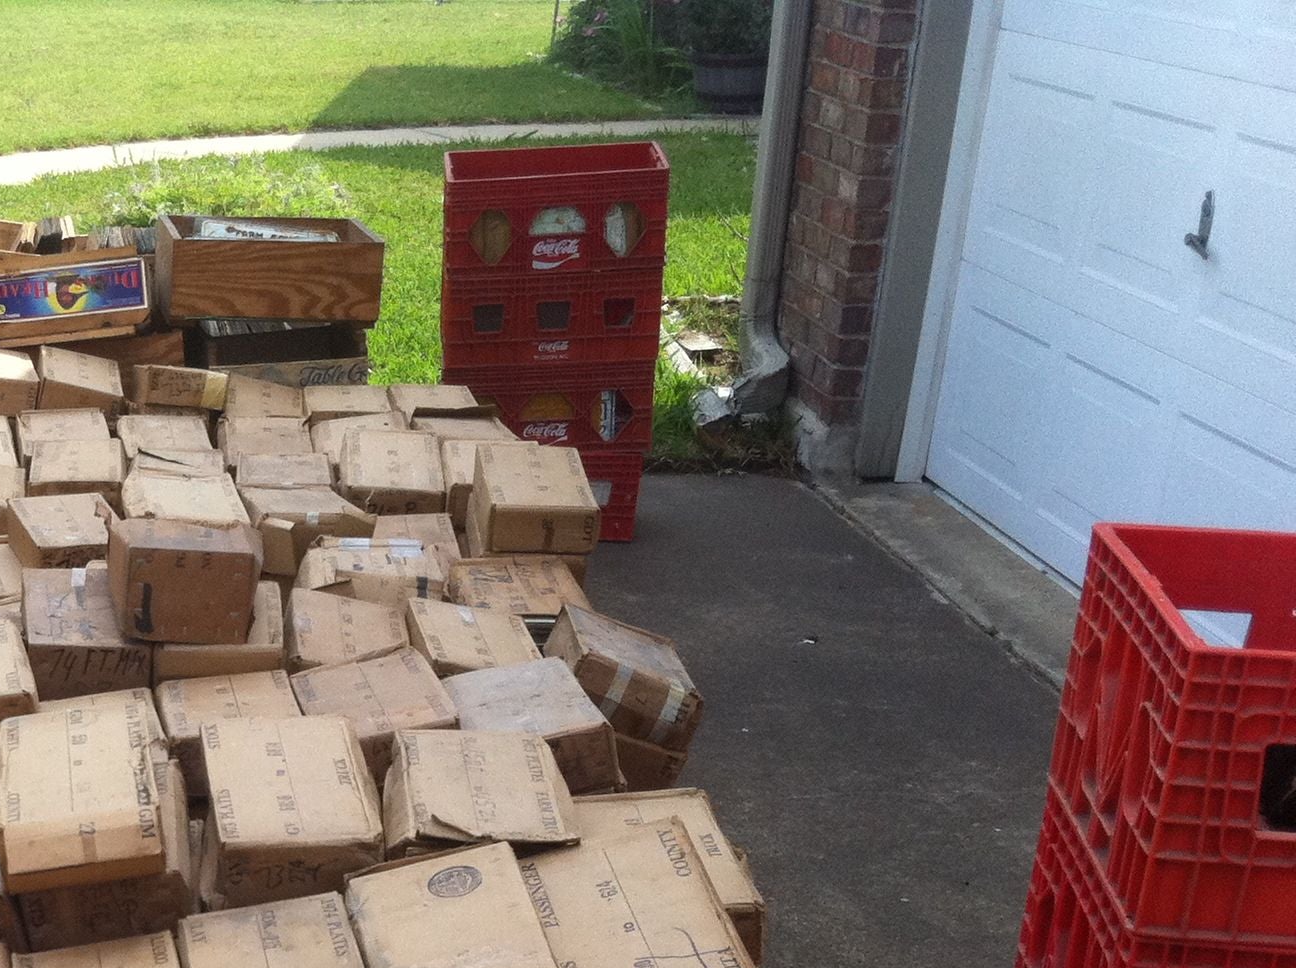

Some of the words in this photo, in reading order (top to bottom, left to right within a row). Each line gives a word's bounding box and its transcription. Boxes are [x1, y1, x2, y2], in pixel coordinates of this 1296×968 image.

[532, 239, 580, 257] Coca-Cola
[656, 828, 693, 878] COUNTY
[520, 862, 560, 929] PASSENGER
